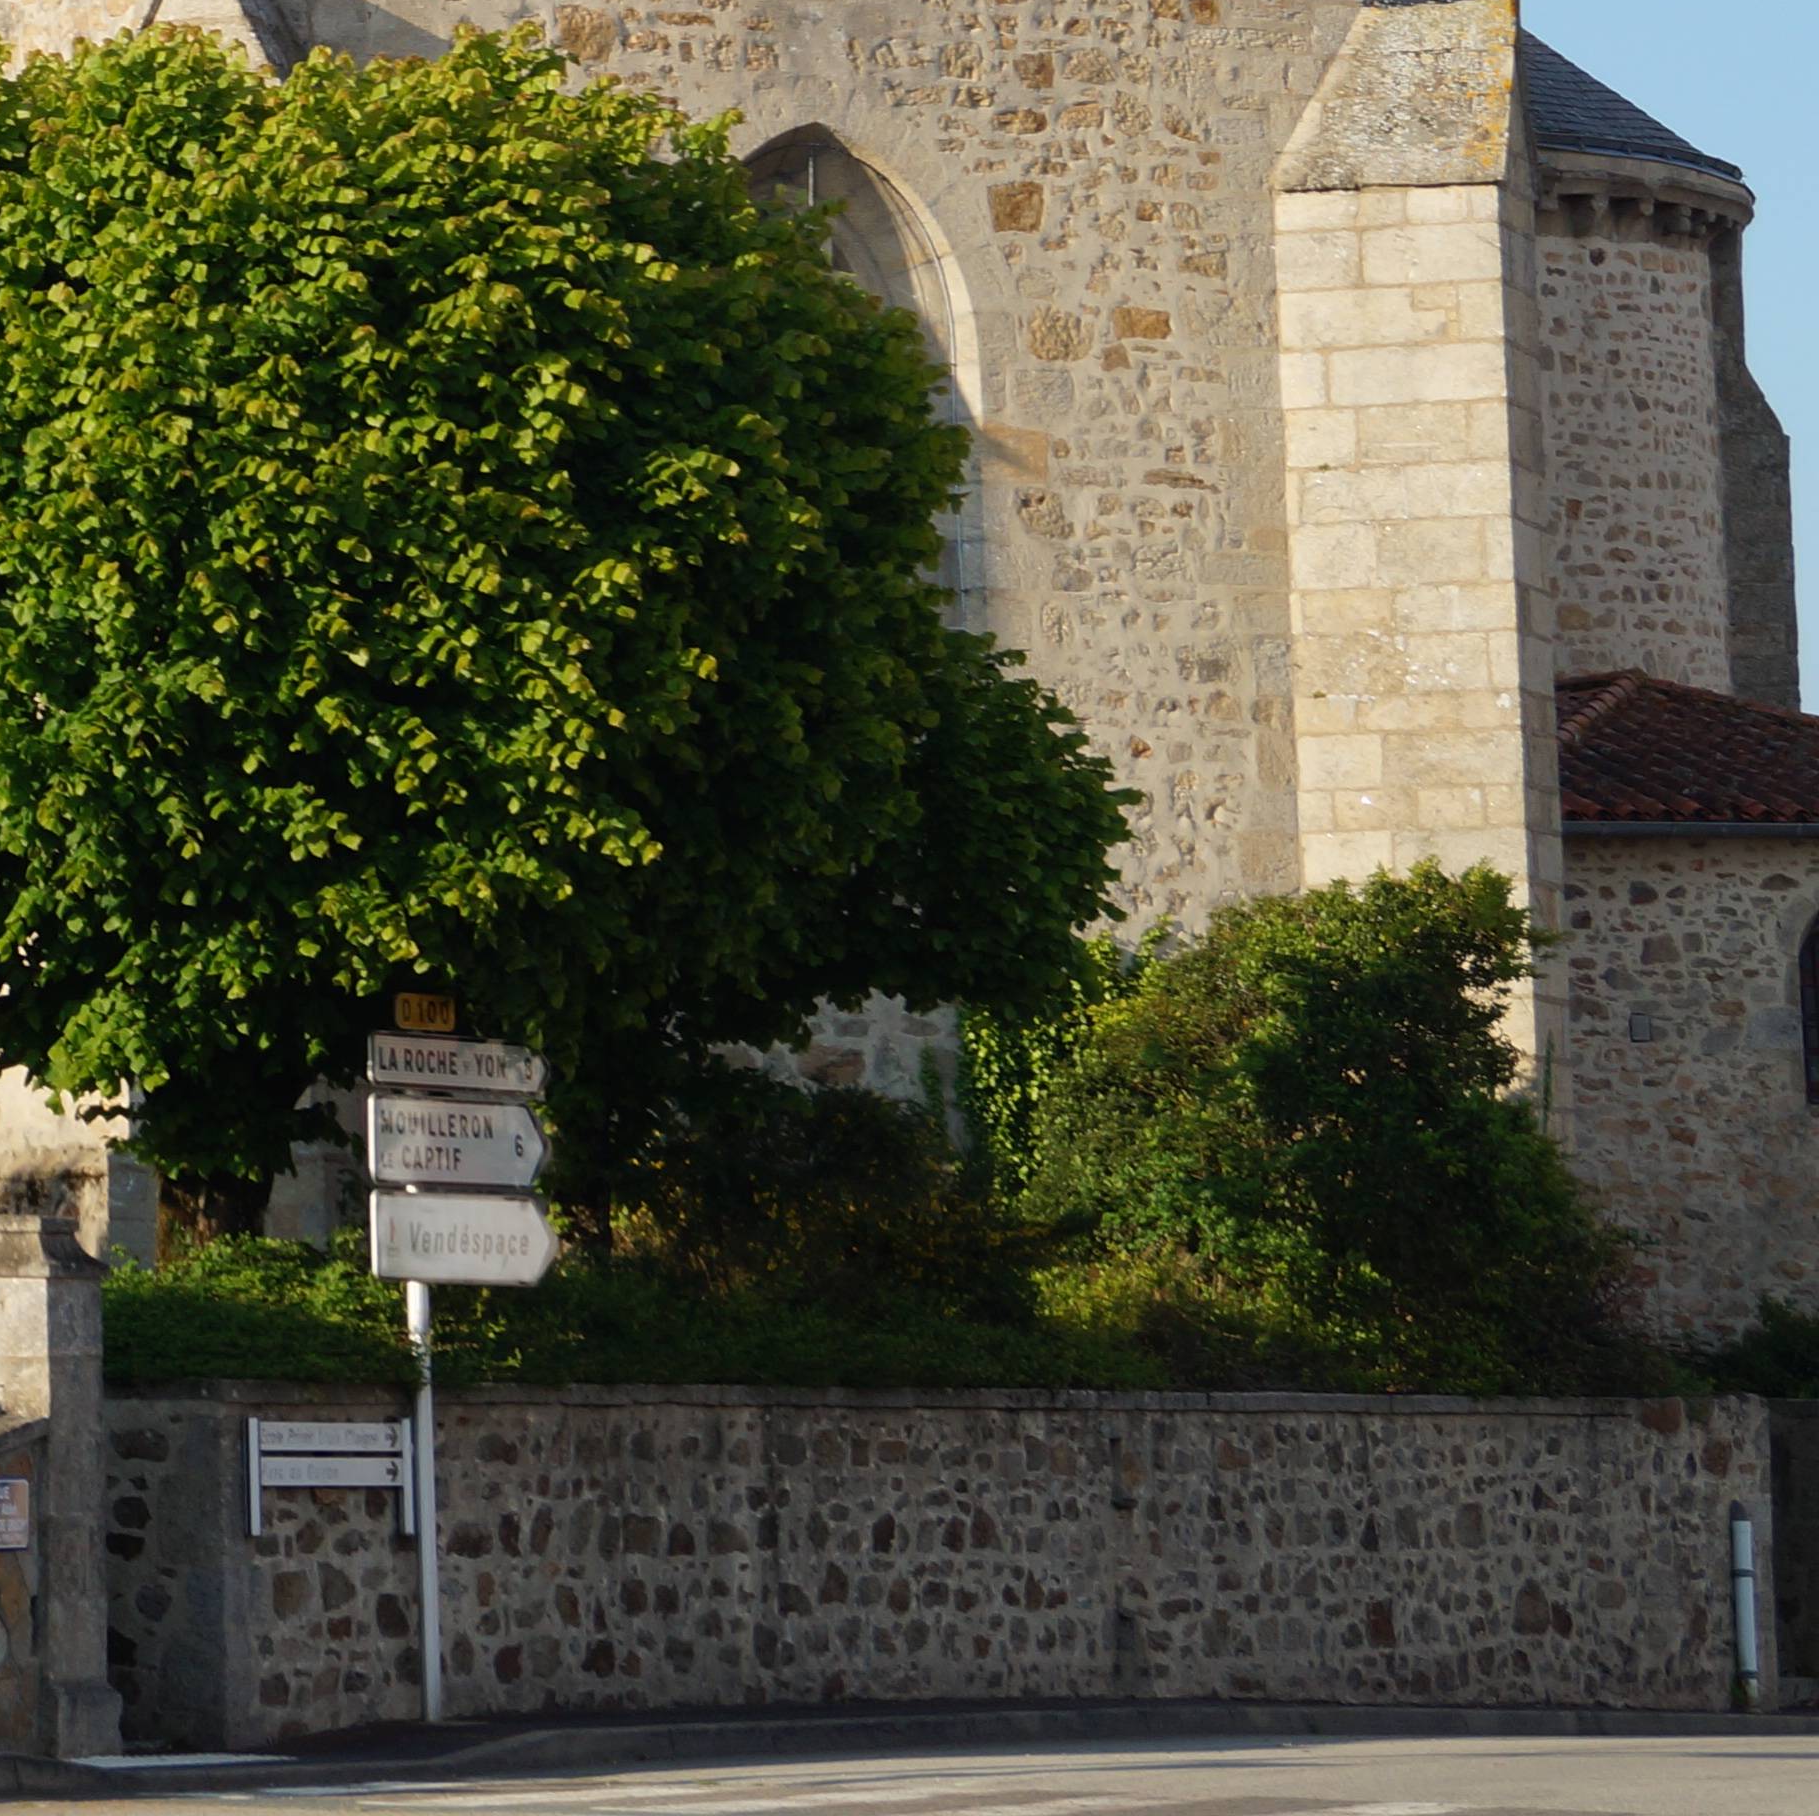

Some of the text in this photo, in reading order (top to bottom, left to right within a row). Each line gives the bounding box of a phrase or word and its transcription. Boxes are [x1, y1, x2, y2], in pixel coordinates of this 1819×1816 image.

[402, 999, 412, 1022] D
[378, 1047, 398, 1071] LA
[404, 1048, 459, 1076] ROCHE
[380, 1109, 494, 1139] MOUILLERON
[402, 1145, 462, 1171] CAPTIF
[514, 1133, 524, 1158] 6
[409, 1221, 530, 1262] Vendéspace
